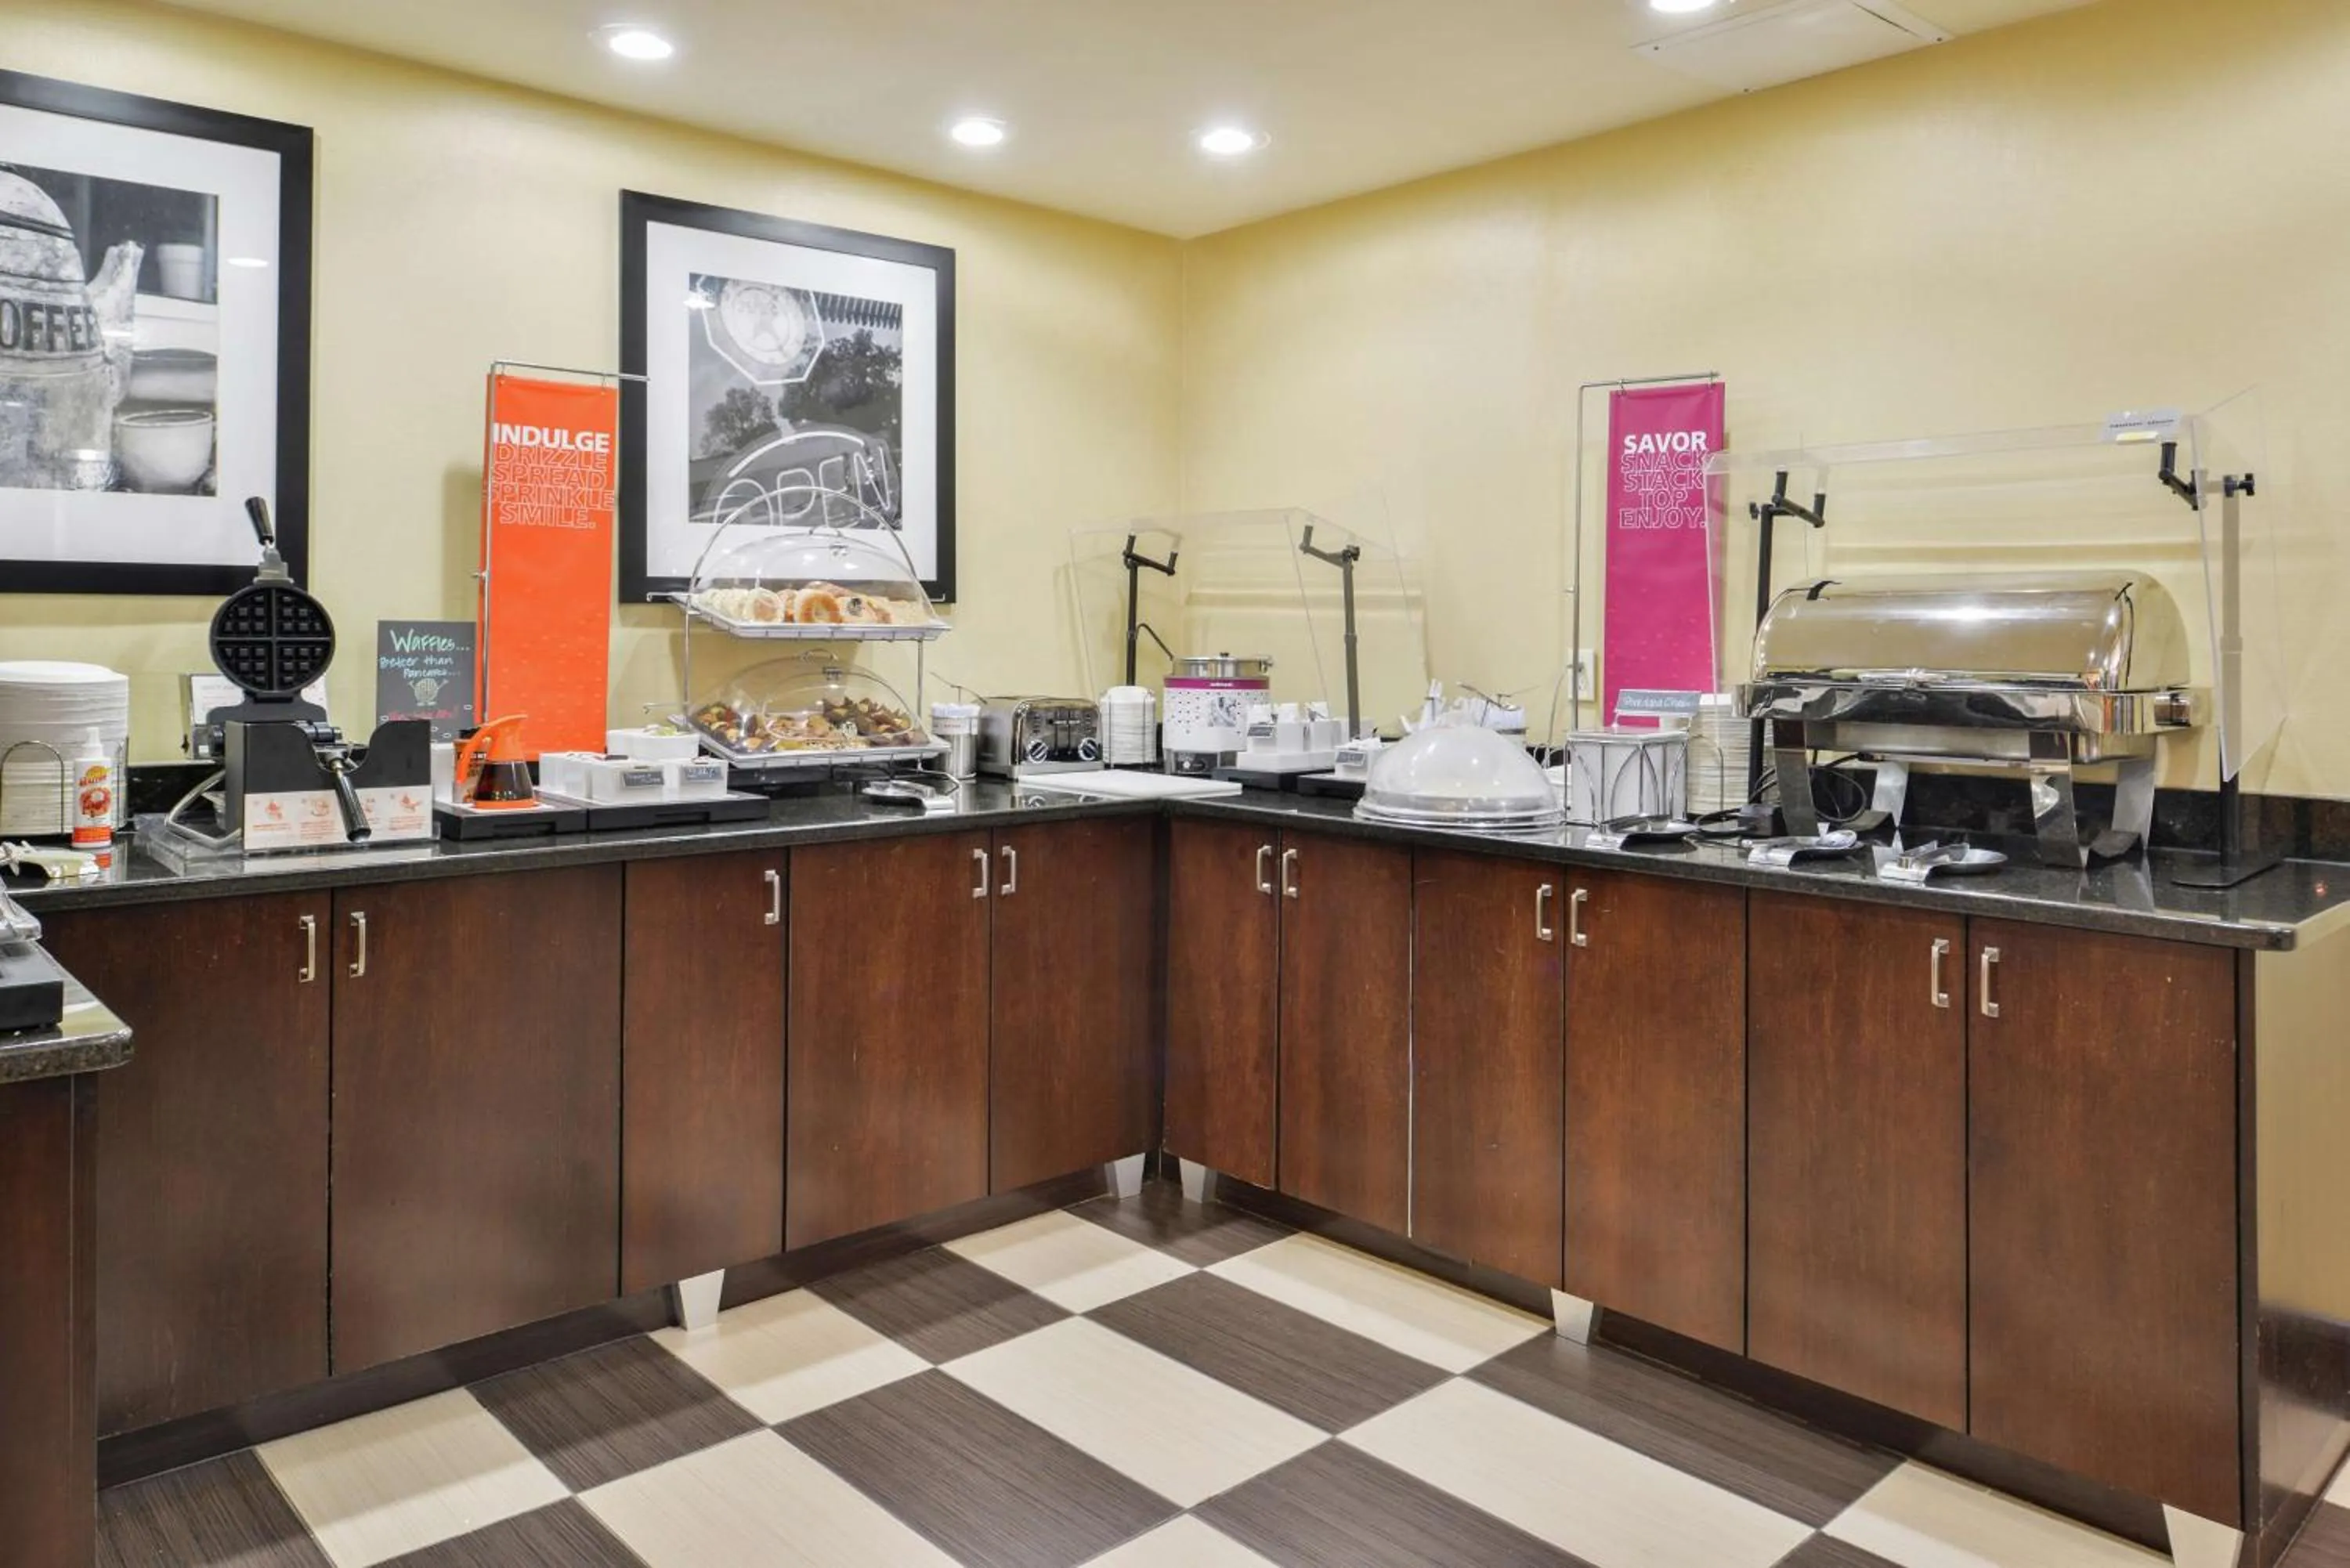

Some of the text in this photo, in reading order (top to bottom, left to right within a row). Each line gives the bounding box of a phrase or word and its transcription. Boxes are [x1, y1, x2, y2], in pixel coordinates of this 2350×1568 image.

[493, 423, 610, 453] INDULGE
[1624, 432, 1708, 453] SAVOR
[497, 444, 608, 471] DRIZZLE
[1621, 449, 1708, 473] SNACK
[491, 462, 608, 490] SPREAD
[1623, 470, 1705, 493] STACK
[483, 481, 615, 511] SPRINKLE
[1639, 488, 1689, 510] TOP
[499, 502, 596, 529] SMILE.
[1619, 507, 1706, 529] ENJOY.
